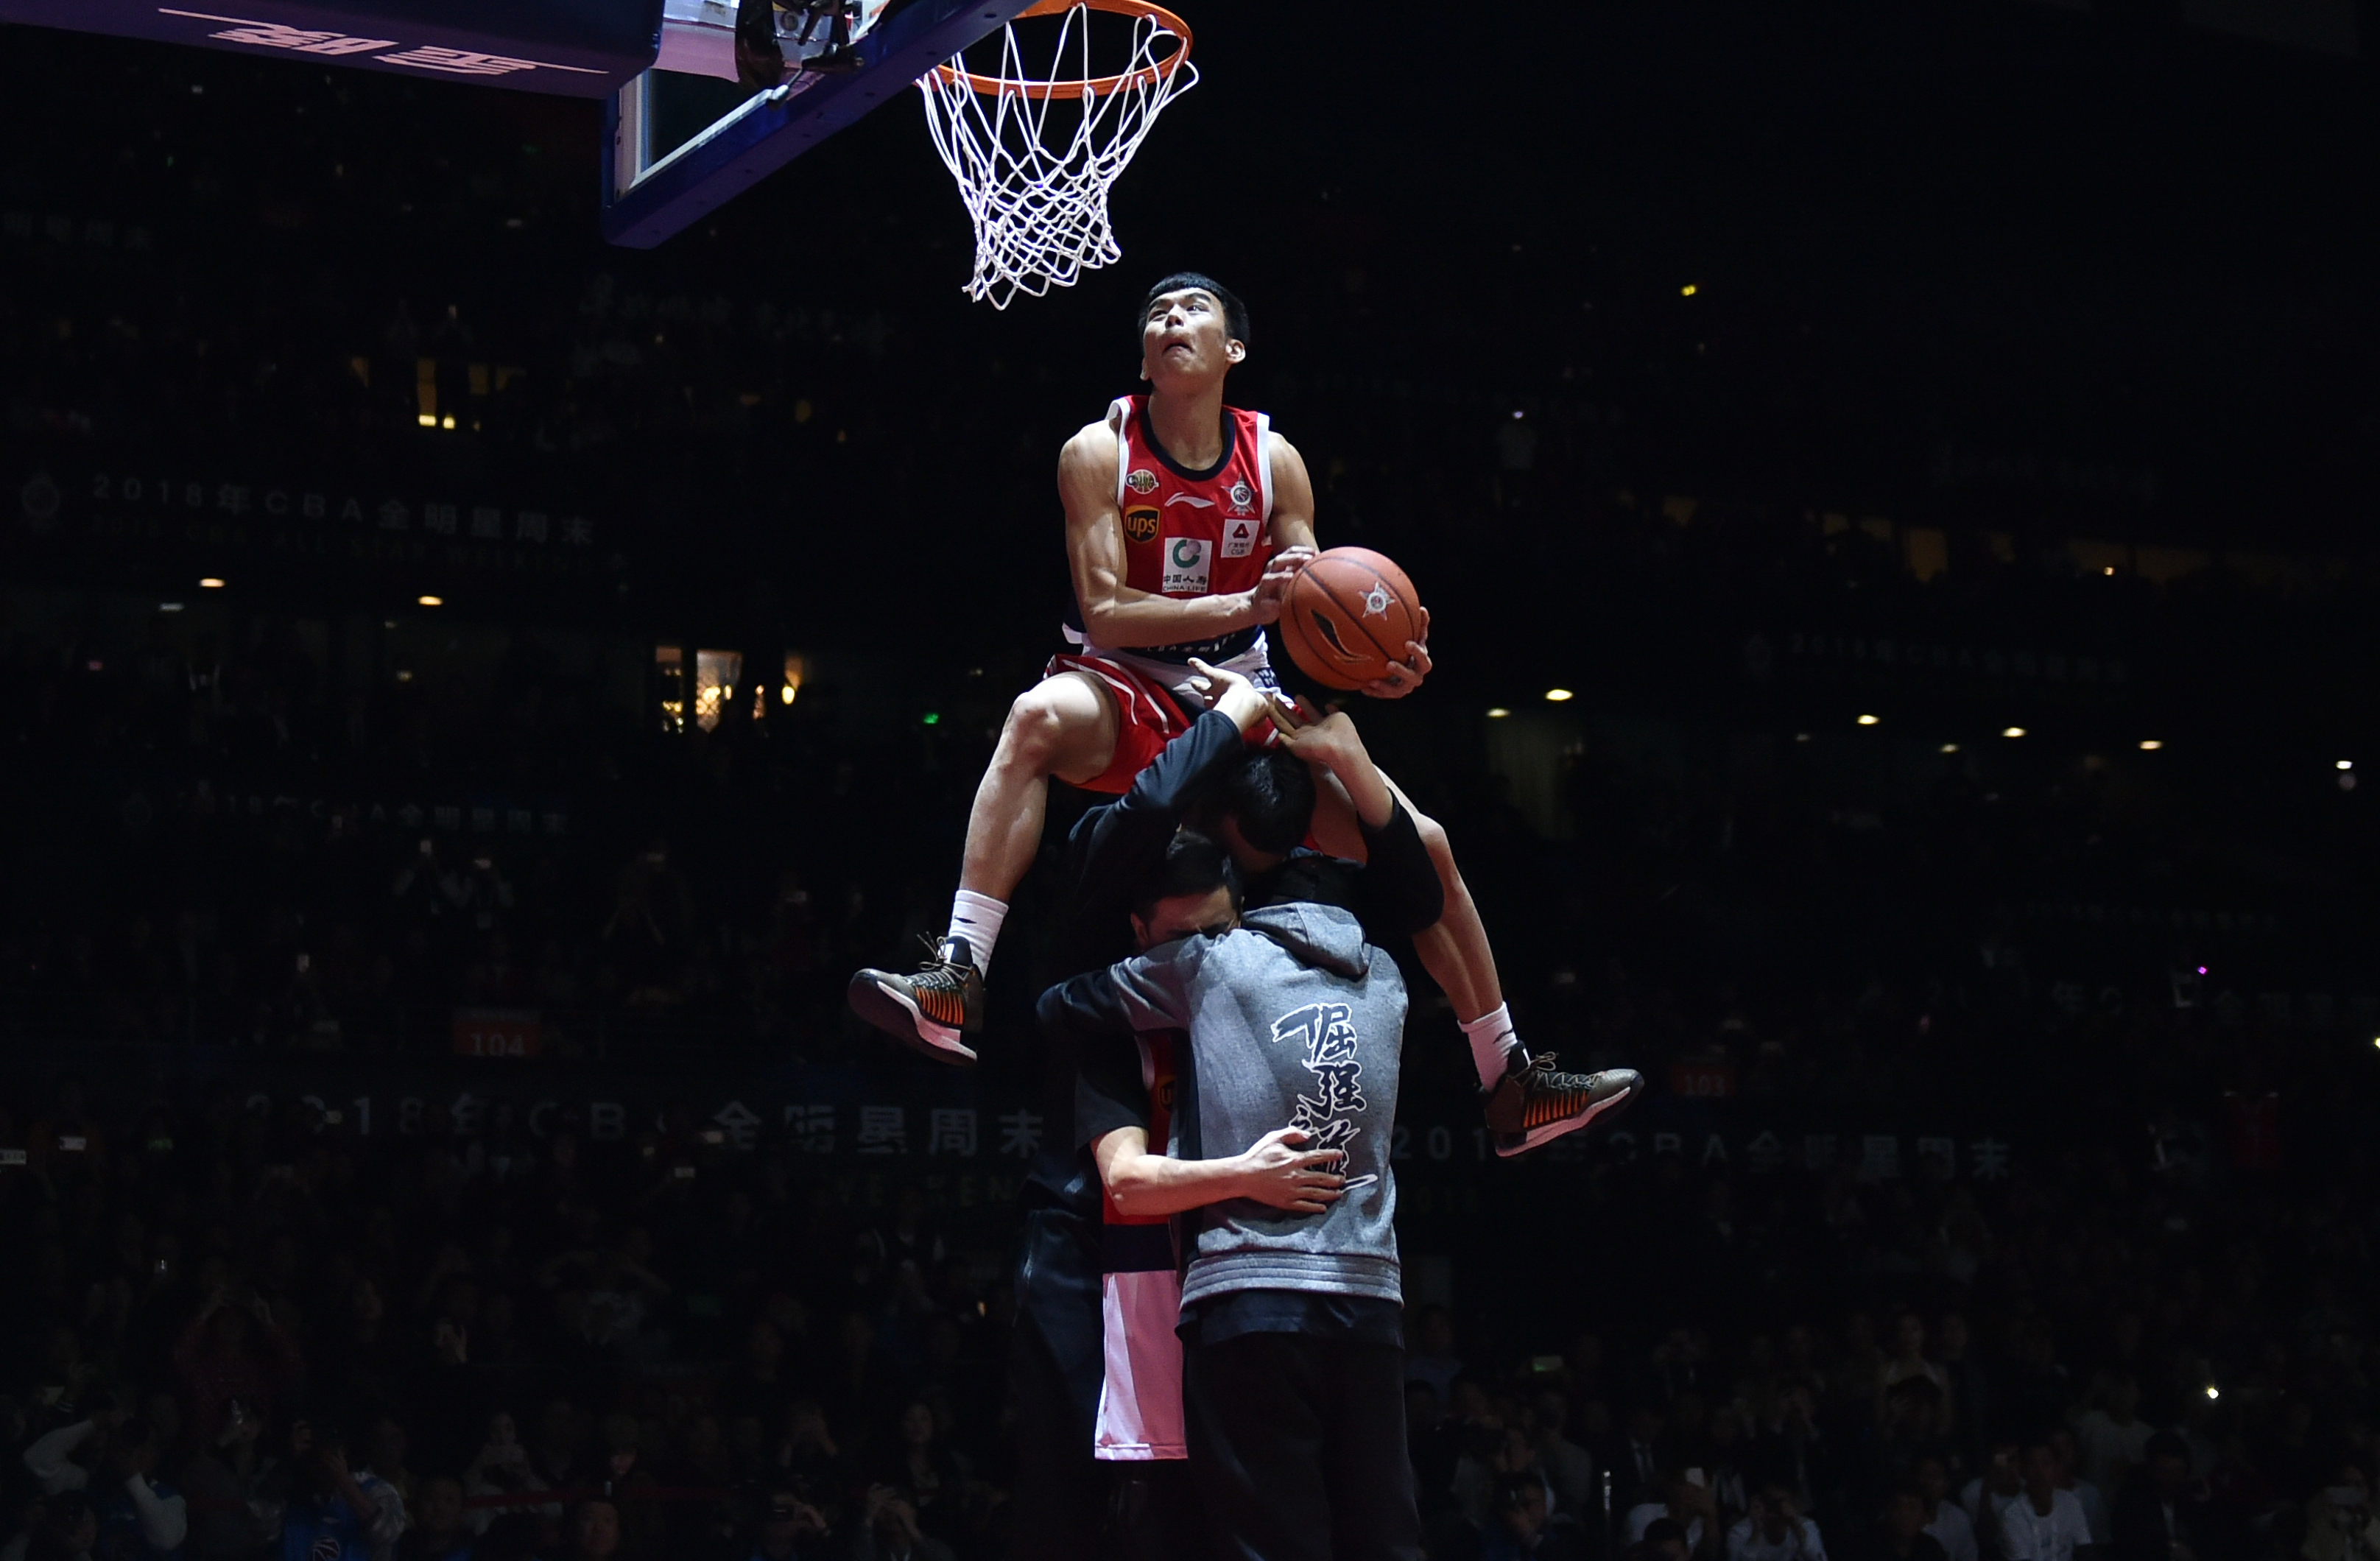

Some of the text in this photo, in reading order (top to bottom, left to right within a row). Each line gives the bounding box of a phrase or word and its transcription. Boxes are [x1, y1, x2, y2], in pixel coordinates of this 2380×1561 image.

[93, 473, 594, 546] 2018年CBA全明星周末
[1127, 517, 1156, 538] ups
[1163, 574, 1208, 585] 中国人寿
[470, 1032, 526, 1057] 104
[1684, 1074, 1725, 1096] 103
